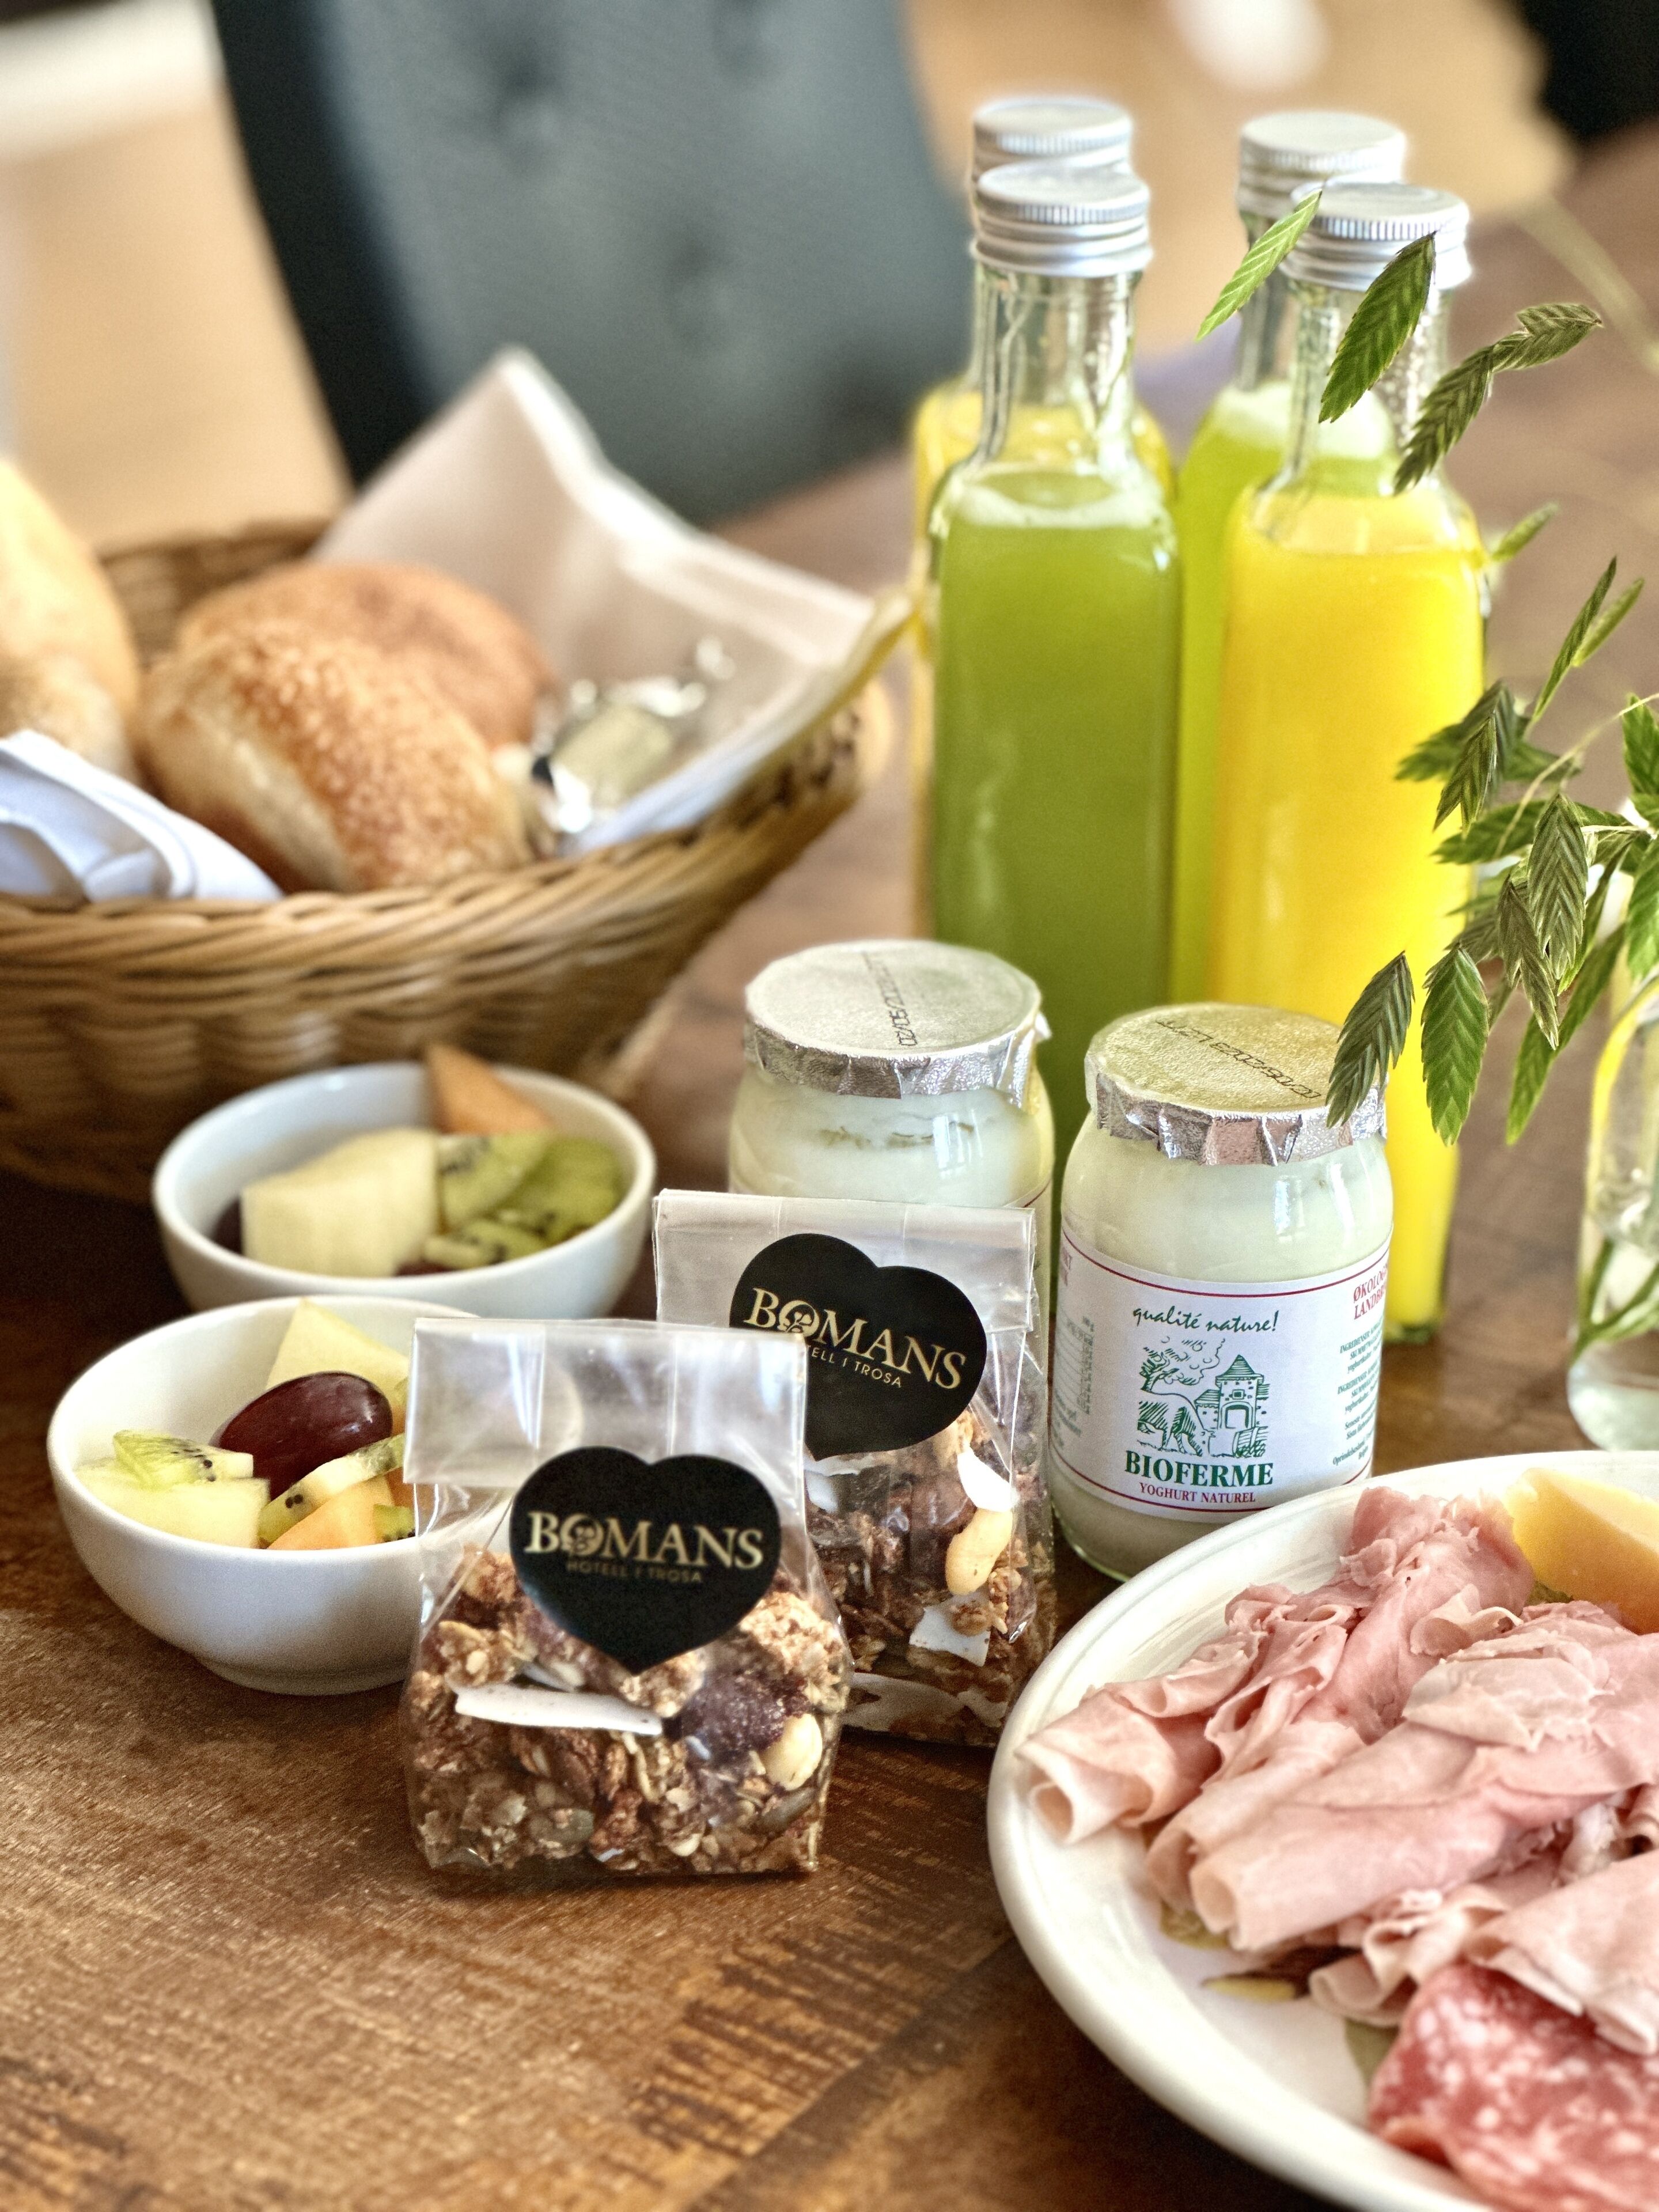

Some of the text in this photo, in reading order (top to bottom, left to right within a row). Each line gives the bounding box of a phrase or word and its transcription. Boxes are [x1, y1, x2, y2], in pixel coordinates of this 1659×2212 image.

[1132, 1305, 1279, 1333] qualité nature!
[743, 1287, 967, 1389] BOMANS
[806, 1345, 903, 1389] TELL I TROSA
[1124, 1450, 1274, 1487] BIOFERME
[1139, 1482, 1256, 1503] YOGHURT NATUREL
[524, 1510, 763, 1570] BOMANS
[567, 1560, 628, 1578] HOTELL
[647, 1566, 702, 1583] TROSA
